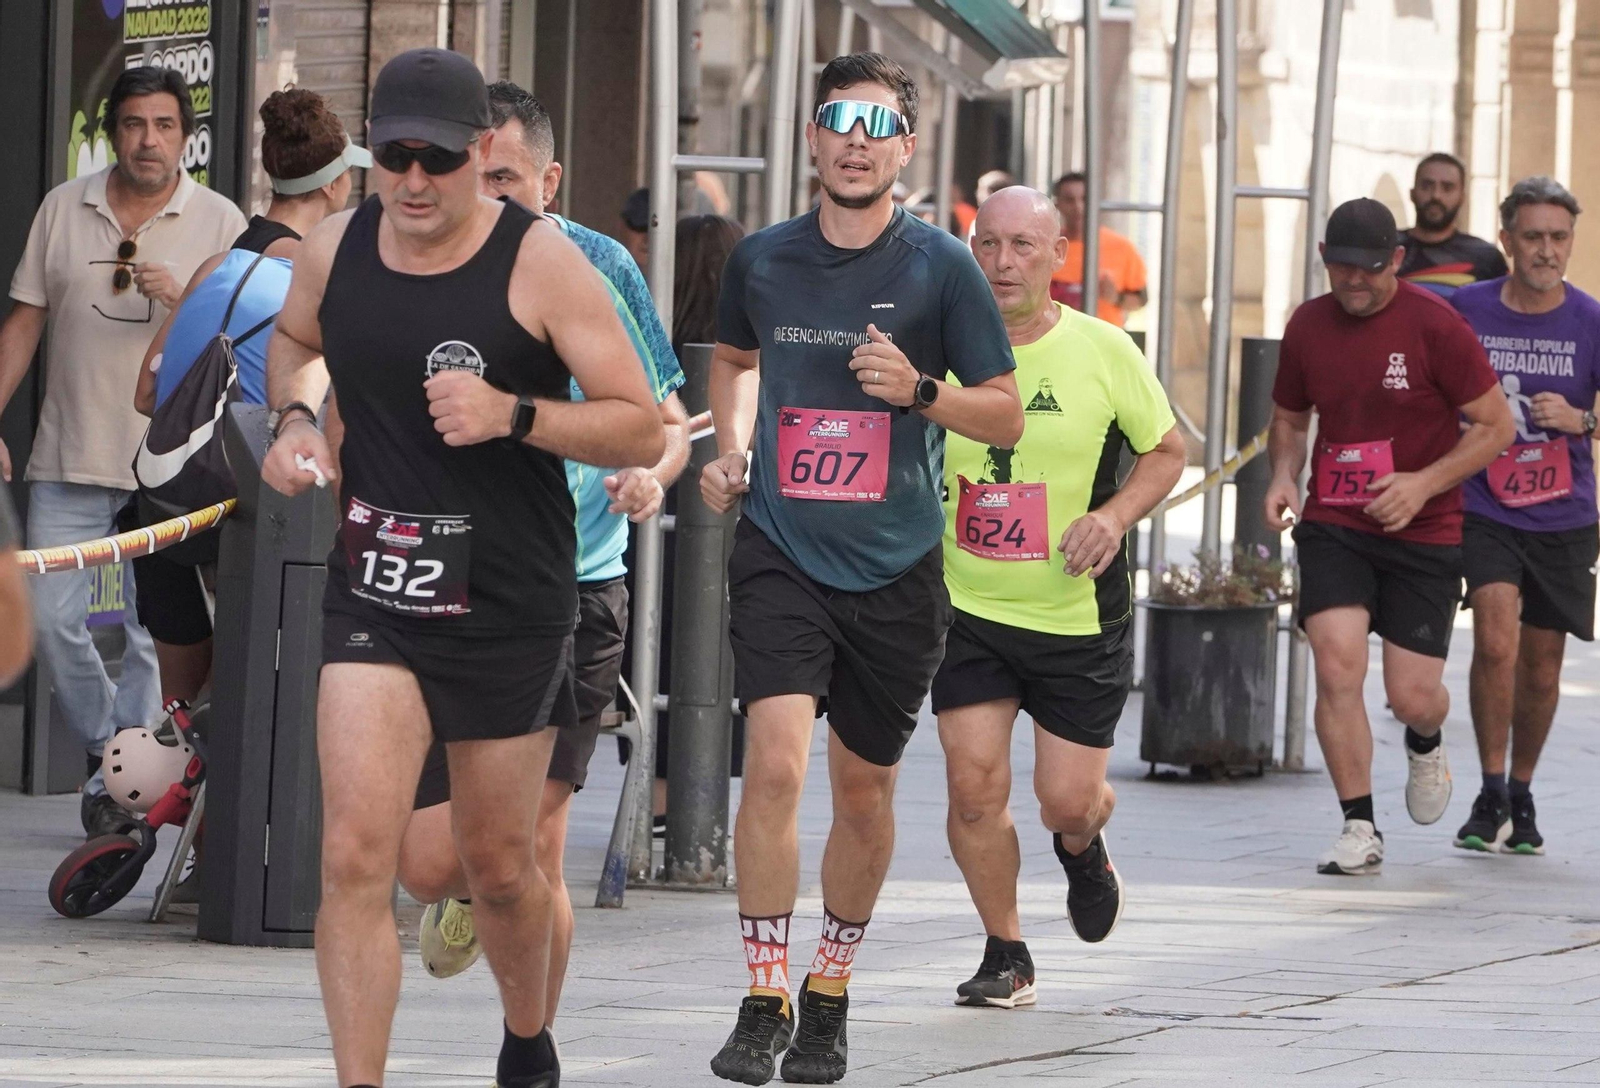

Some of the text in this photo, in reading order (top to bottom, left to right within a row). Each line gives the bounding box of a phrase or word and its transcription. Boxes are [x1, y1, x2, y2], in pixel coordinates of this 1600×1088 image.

[126, 6, 209, 38] NAVIDAD 2023
[1483, 335, 1531, 352] CARREIRA
[1532, 339, 1577, 355] POPULAR
[1489, 350, 1574, 377] RIBADAVIA
[809, 430, 850, 438] INTERRUNNING
[819, 421, 849, 432] CAE
[790, 449, 869, 486] 607
[1503, 466, 1556, 495] 430
[1329, 470, 1376, 495] 757
[982, 493, 1009, 503] CAE
[377, 531, 422, 545] INTERRUNNING
[966, 515, 1026, 549] 624
[361, 551, 444, 598] 132
[741, 917, 787, 945] UN
[744, 941, 785, 965] RAN
